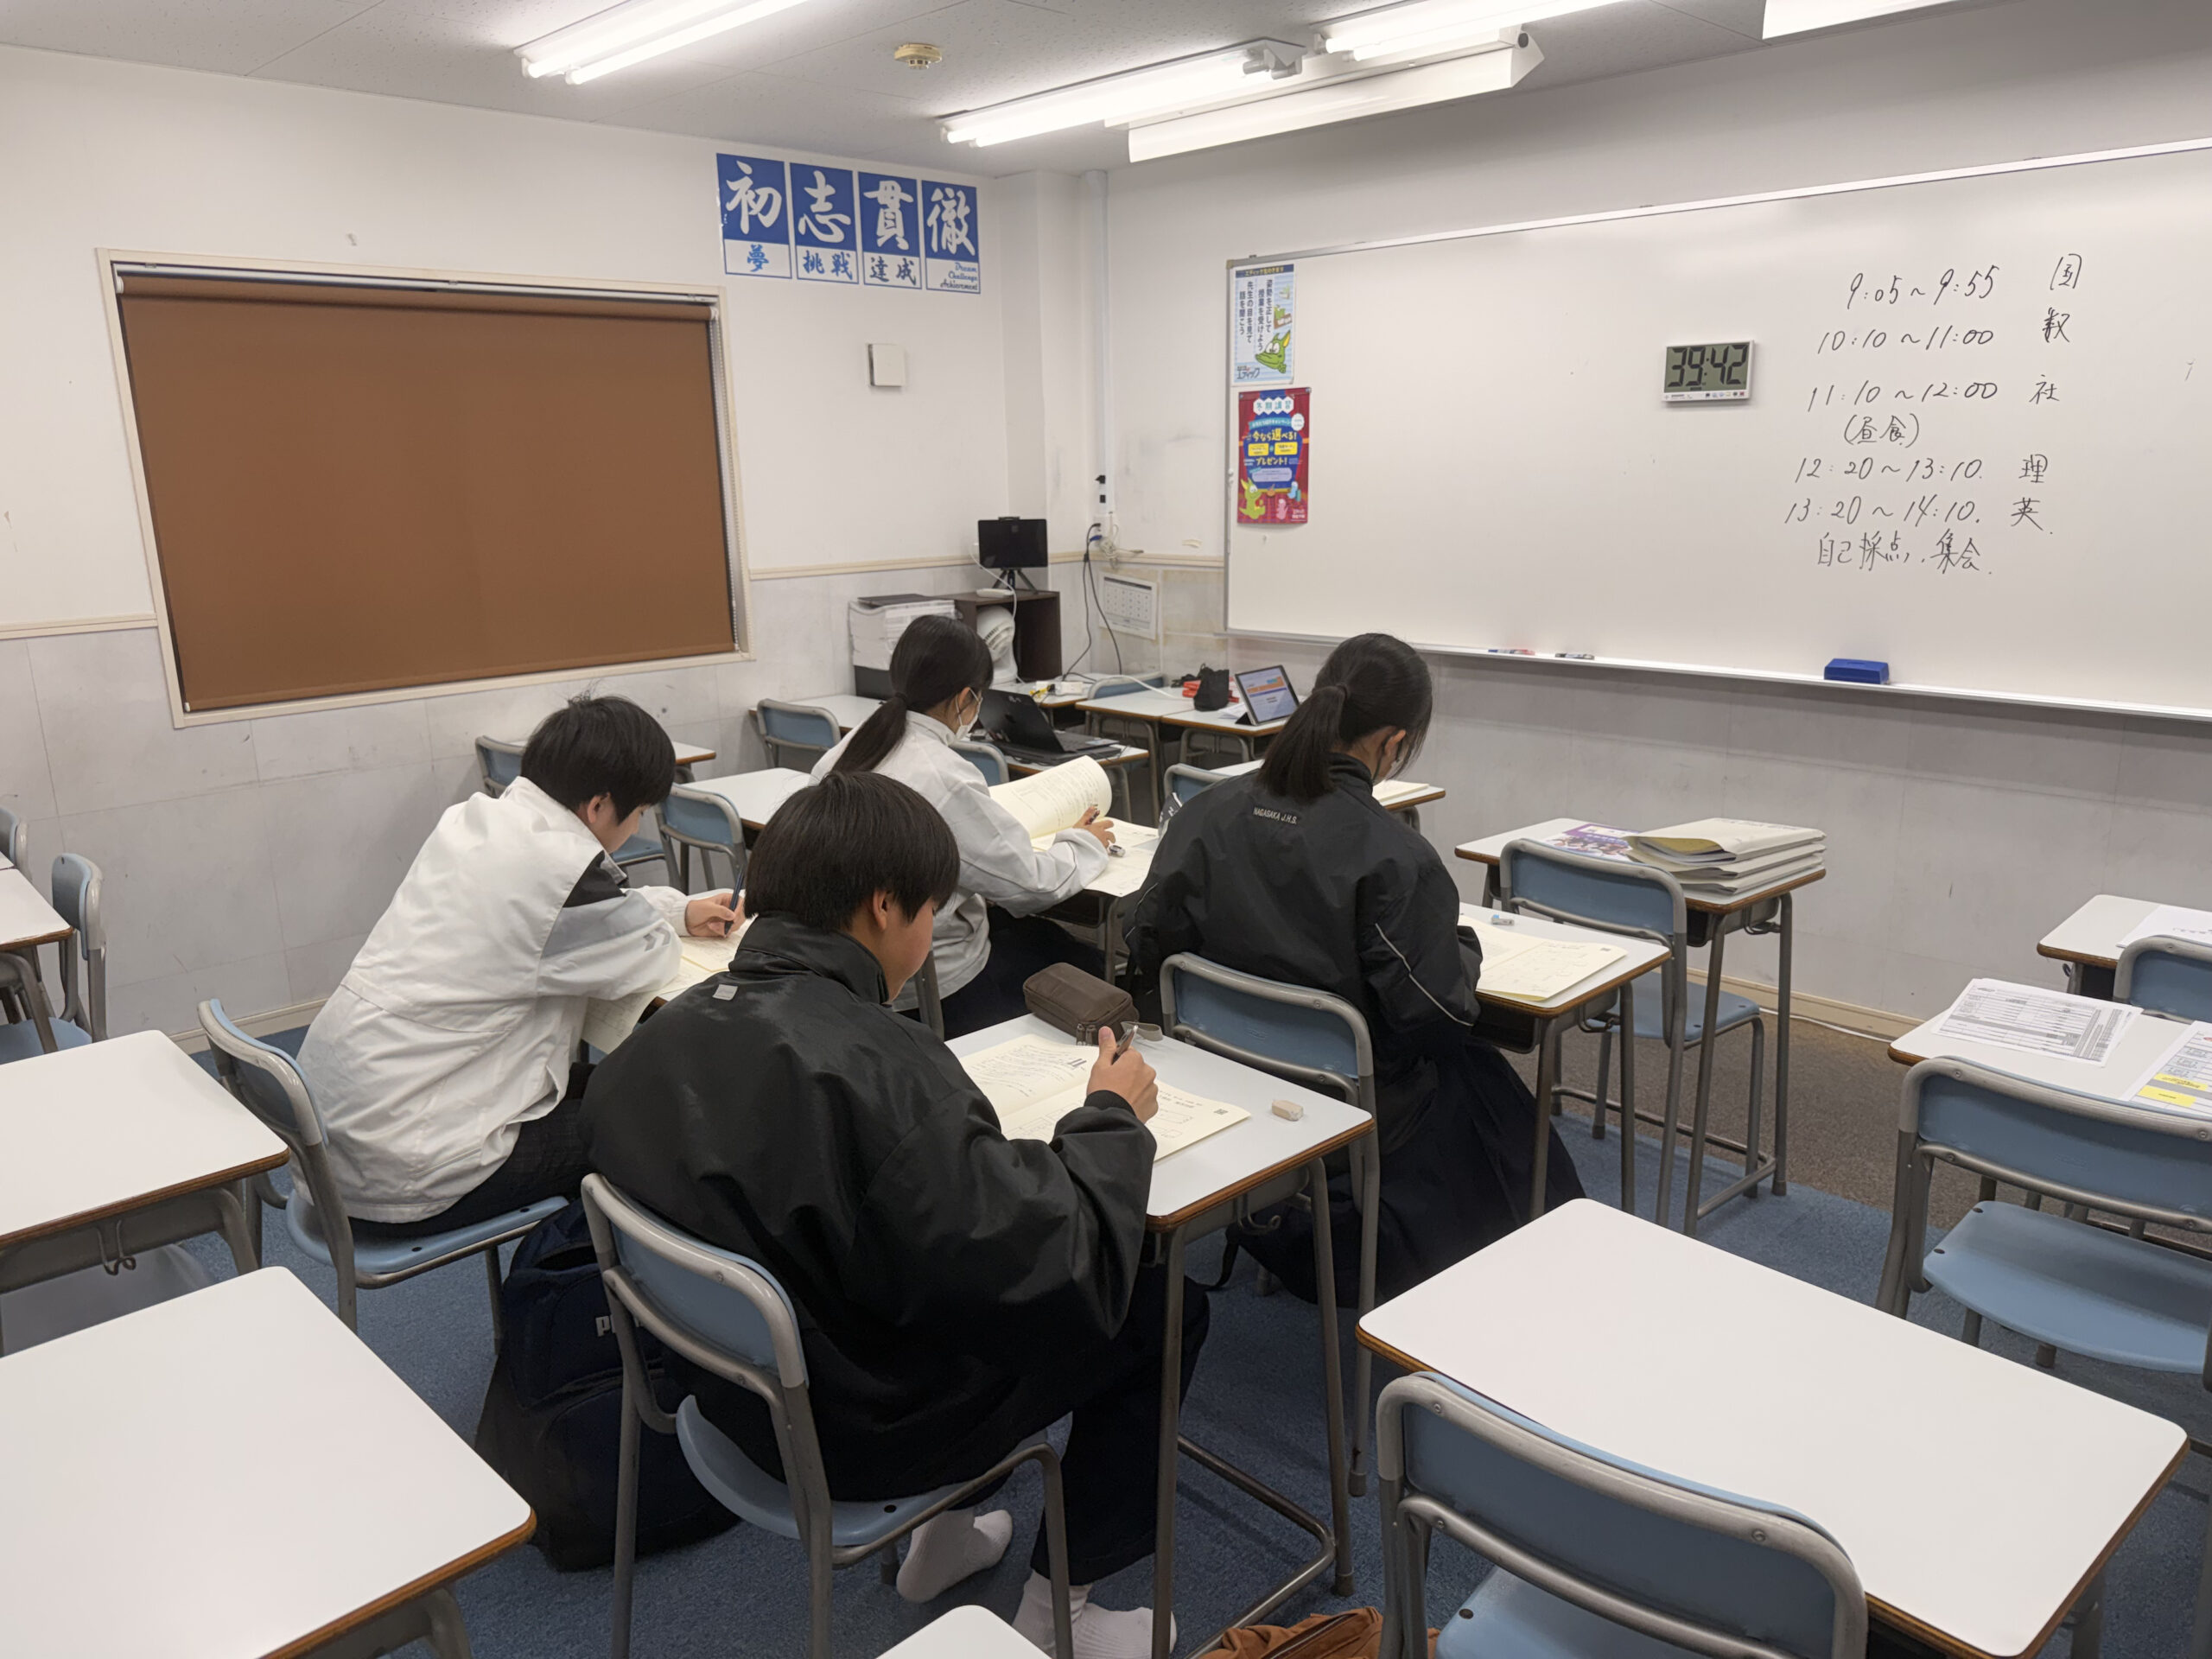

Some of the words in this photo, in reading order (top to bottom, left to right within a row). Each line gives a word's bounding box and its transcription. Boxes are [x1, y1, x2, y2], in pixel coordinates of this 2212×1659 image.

[747, 245, 770, 272] 夢
[802, 250, 853, 281] 挑戦
[869, 257, 917, 286] 達成
[955, 262, 977, 272] Dream
[2050, 253, 2082, 290] 国
[2042, 307, 2070, 343] 数
[1668, 345, 1748, 387] 39:42
[2029, 374, 2060, 404] 社
[1256, 400, 1292, 412] 冬期講習
[2018, 454, 2048, 483] 理
[1253, 807, 1281, 821] NAGASAKA
